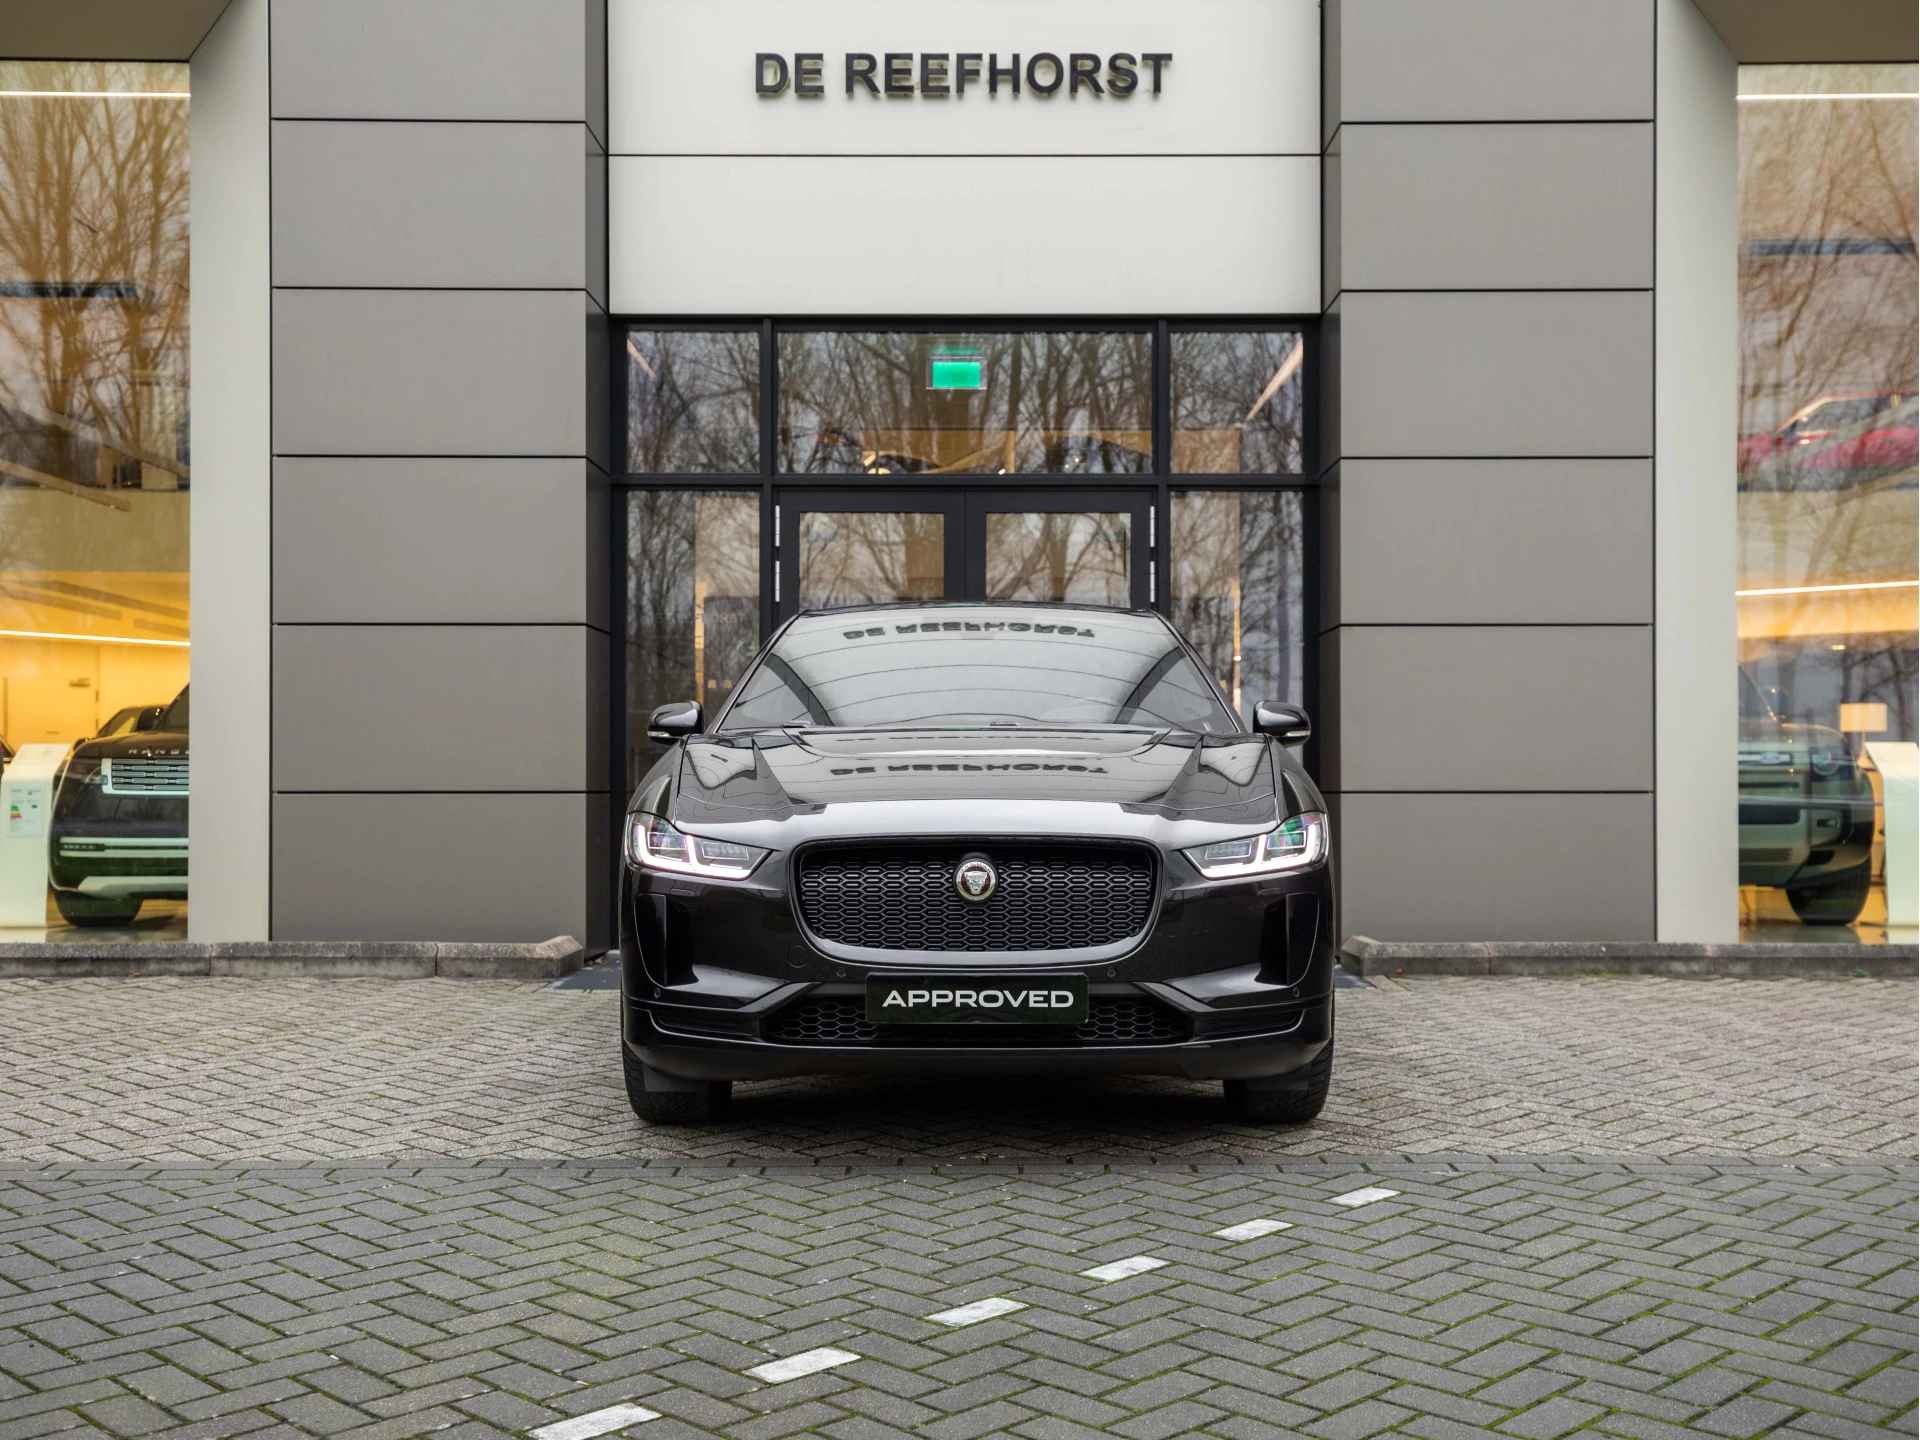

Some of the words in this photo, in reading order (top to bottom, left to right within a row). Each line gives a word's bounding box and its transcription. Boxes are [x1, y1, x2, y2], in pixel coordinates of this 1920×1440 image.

[755, 52, 825, 95] DE
[844, 52, 1173, 95] REEFHORST
[881, 990, 1074, 1008] APPROVED
